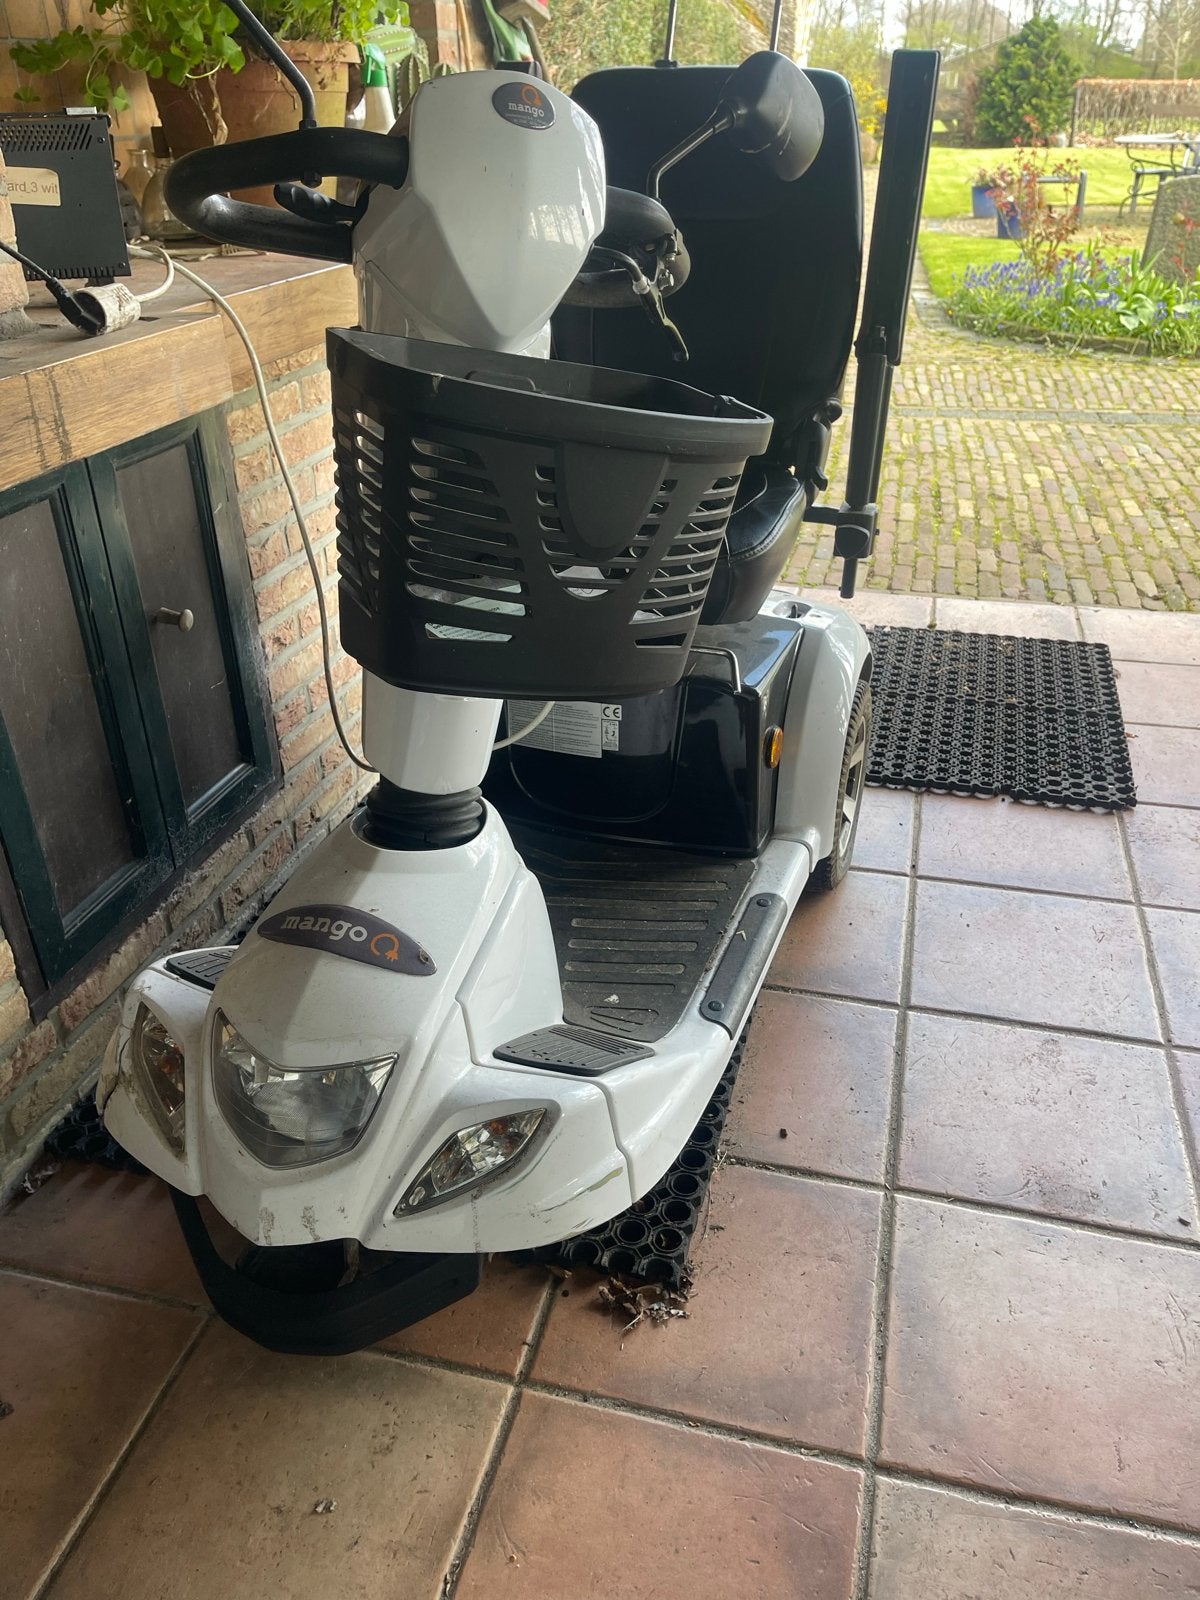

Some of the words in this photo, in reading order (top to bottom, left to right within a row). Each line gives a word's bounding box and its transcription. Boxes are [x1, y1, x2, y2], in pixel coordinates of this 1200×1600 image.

[507, 103, 545, 118] mango
[7, 181, 38, 193] ard_3
[602, 706, 621, 719] CE
[280, 915, 368, 942] mango
